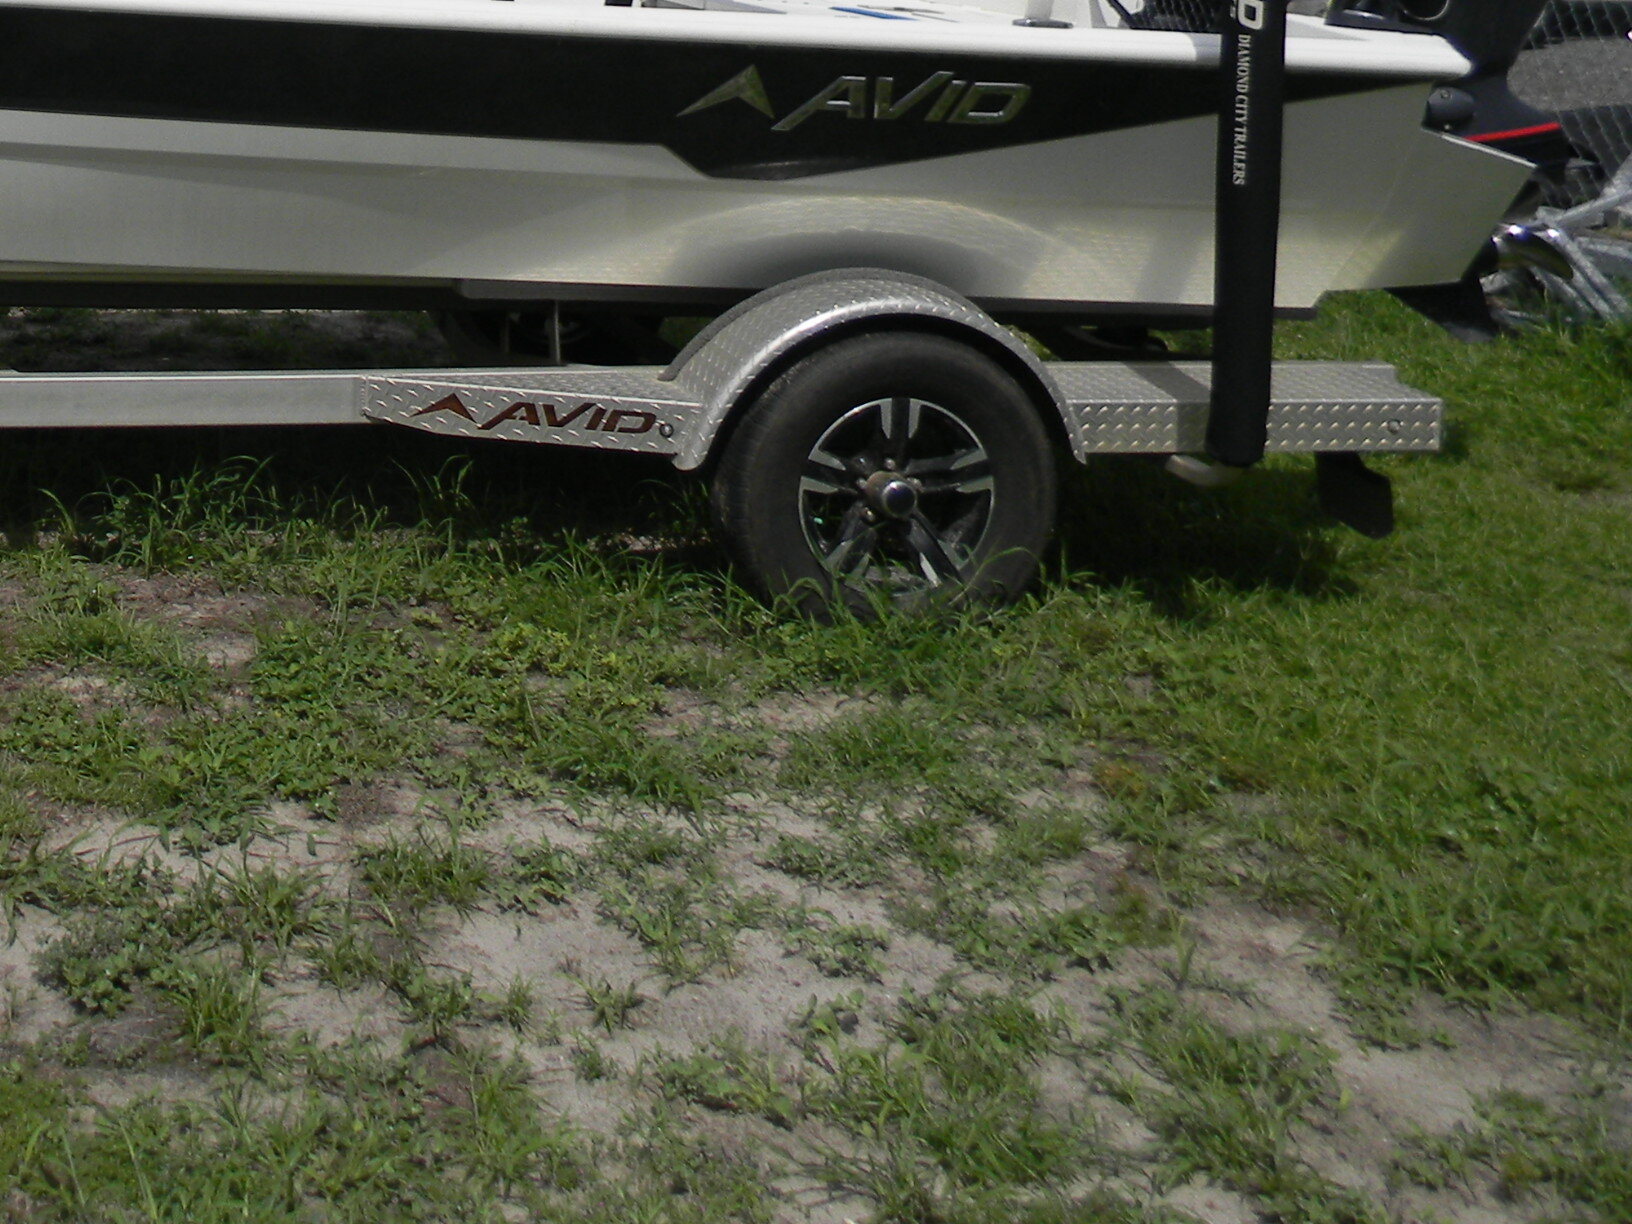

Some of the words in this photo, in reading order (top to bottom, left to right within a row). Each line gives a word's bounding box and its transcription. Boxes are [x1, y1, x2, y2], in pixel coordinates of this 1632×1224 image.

[1236, 34, 1251, 93] DIAMOND
[771, 71, 1031, 131] AVID
[1234, 95, 1249, 123] CITY
[1232, 127, 1248, 186] TRAILERS
[478, 402, 657, 433] AVID
